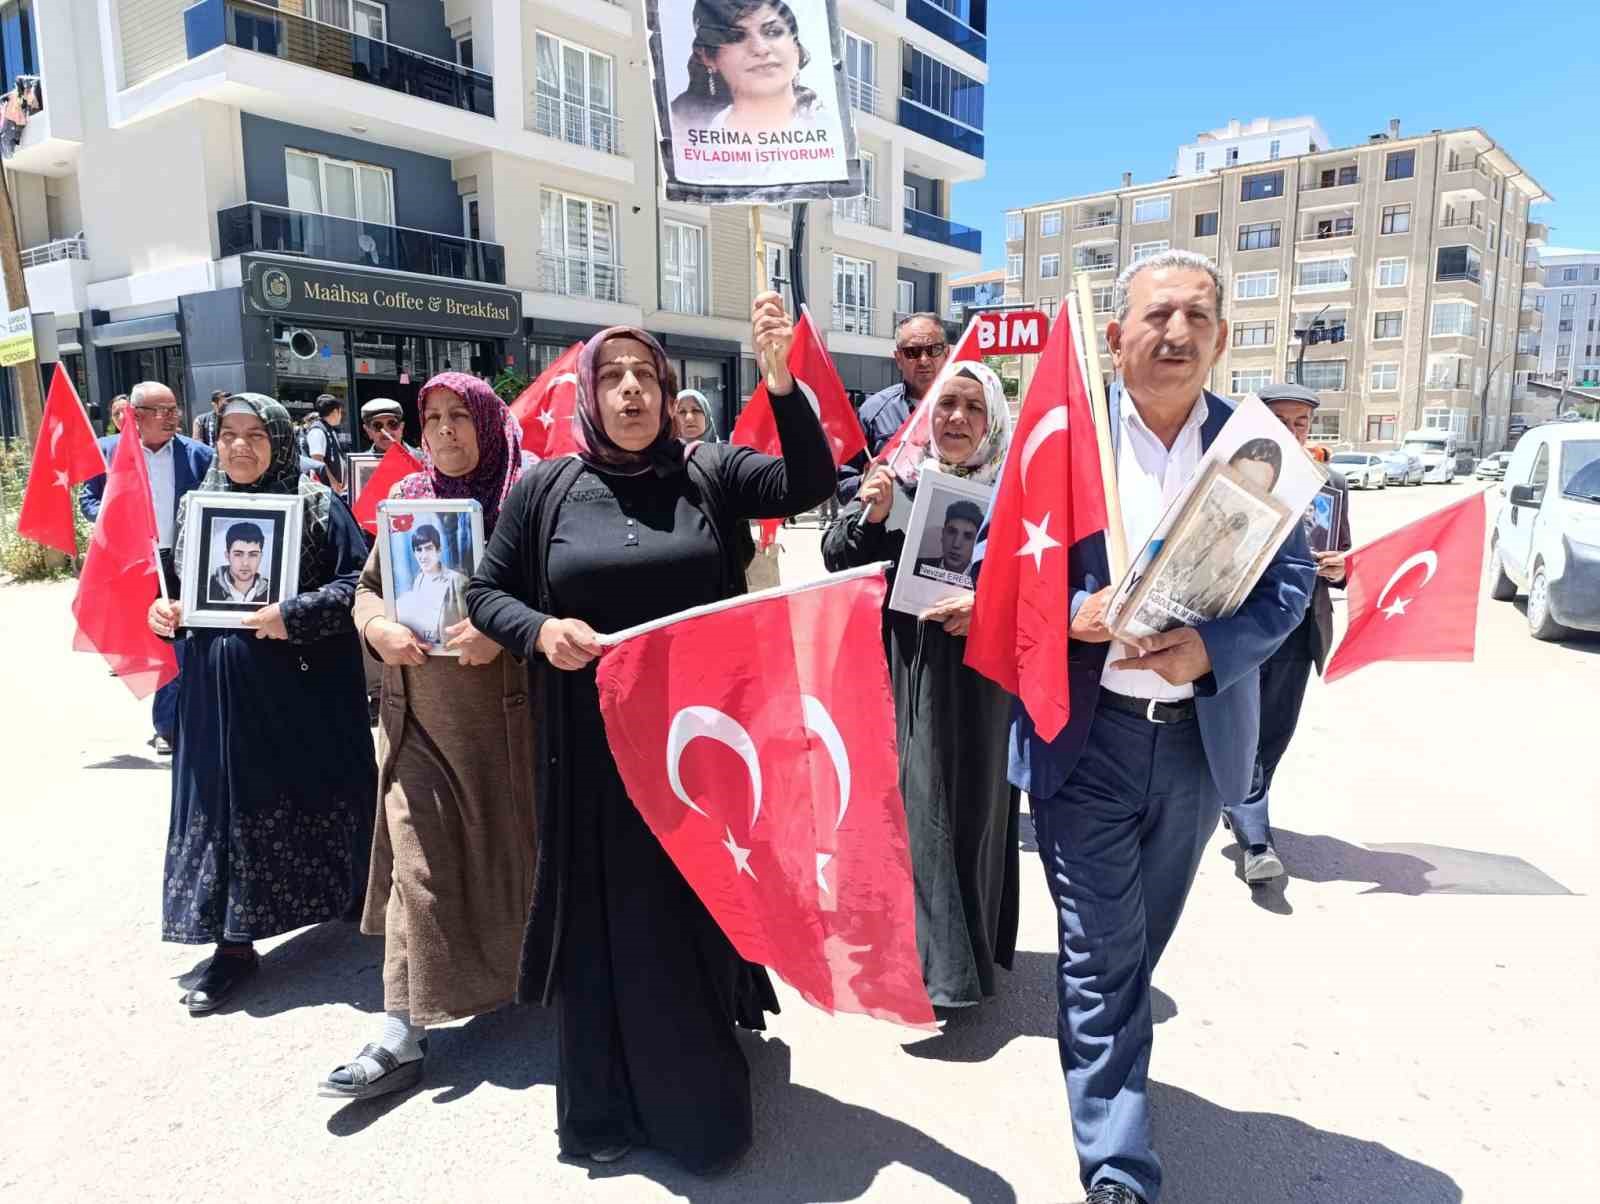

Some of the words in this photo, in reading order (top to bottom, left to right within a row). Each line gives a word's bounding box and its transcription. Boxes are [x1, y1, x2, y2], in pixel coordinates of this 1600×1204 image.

[687, 128, 752, 146] ŞERİMA
[758, 129, 827, 145] SANCAR
[684, 148, 751, 162] EVLADIMI
[755, 147, 835, 162] İSTİYORUM!
[303, 281, 369, 305] Maâhsa
[373, 291, 423, 311] Coffee
[428, 296, 441, 312] &
[446, 299, 510, 320] Breakfast
[978, 313, 1039, 349] BİM
